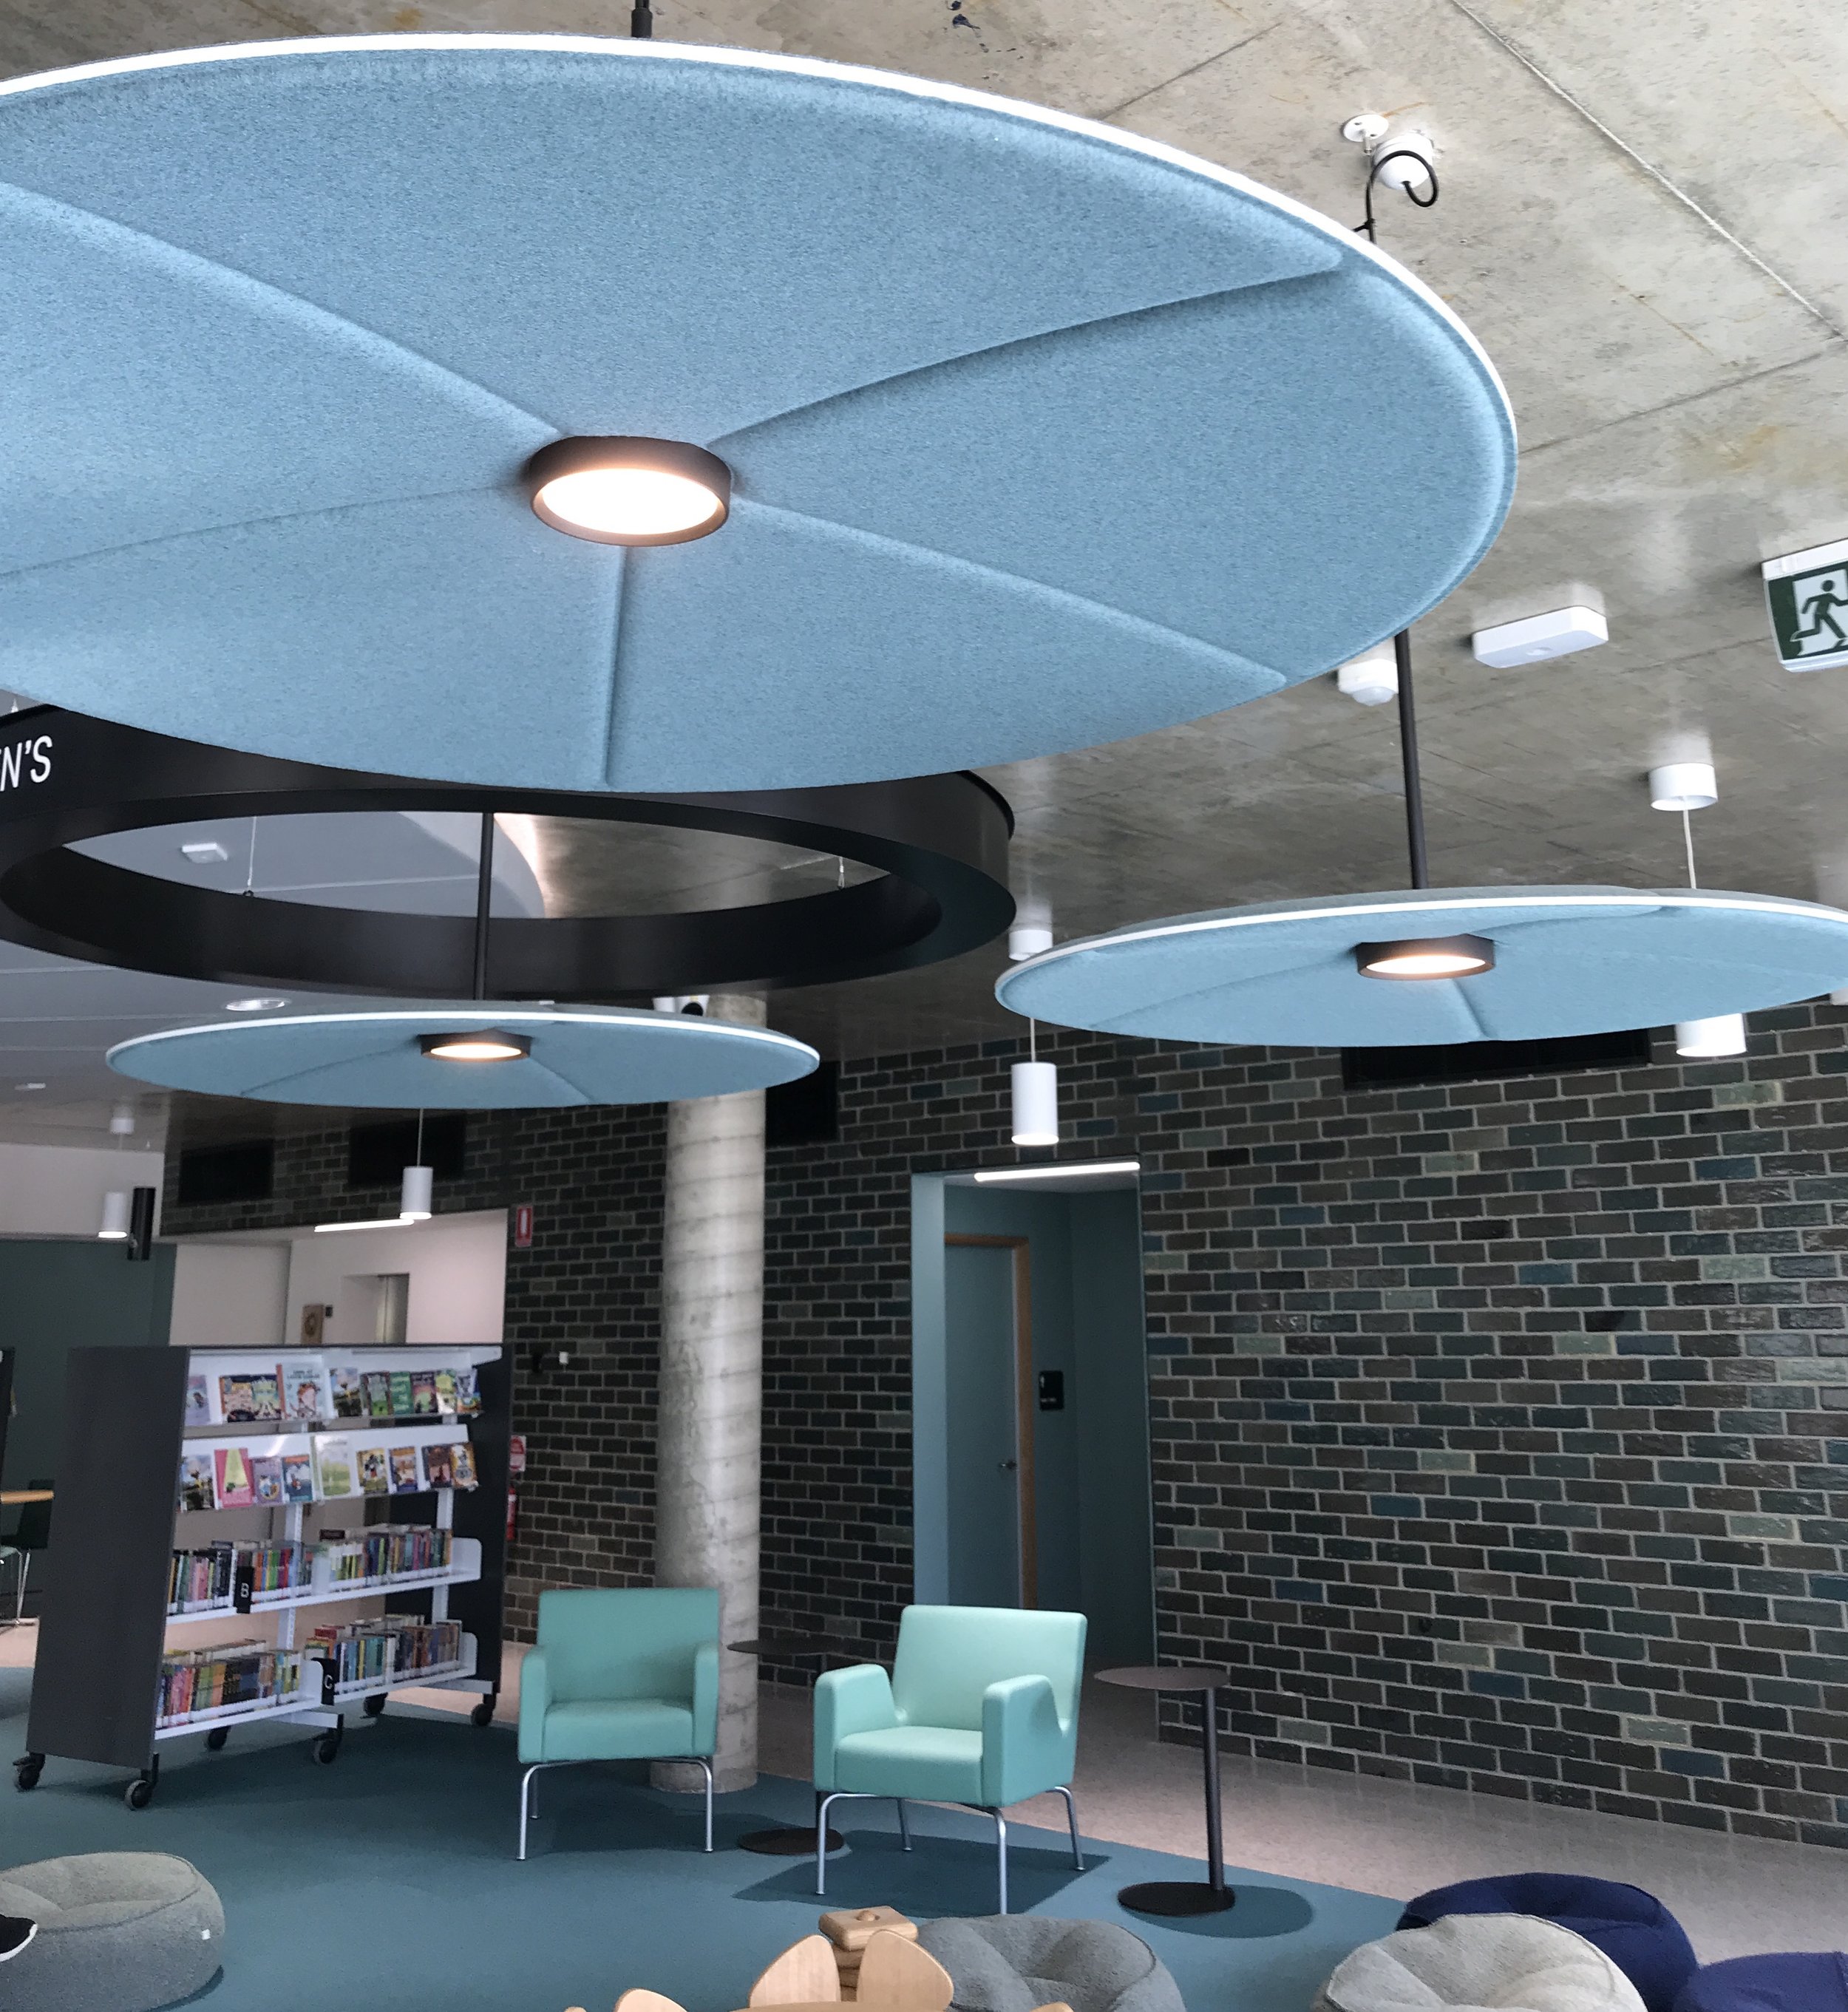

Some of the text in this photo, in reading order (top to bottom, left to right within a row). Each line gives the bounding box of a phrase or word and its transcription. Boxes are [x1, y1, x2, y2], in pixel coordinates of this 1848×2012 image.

[0, 735, 53, 792] N'S
[240, 1583, 250, 1598] B
[325, 1674, 333, 1690] C
